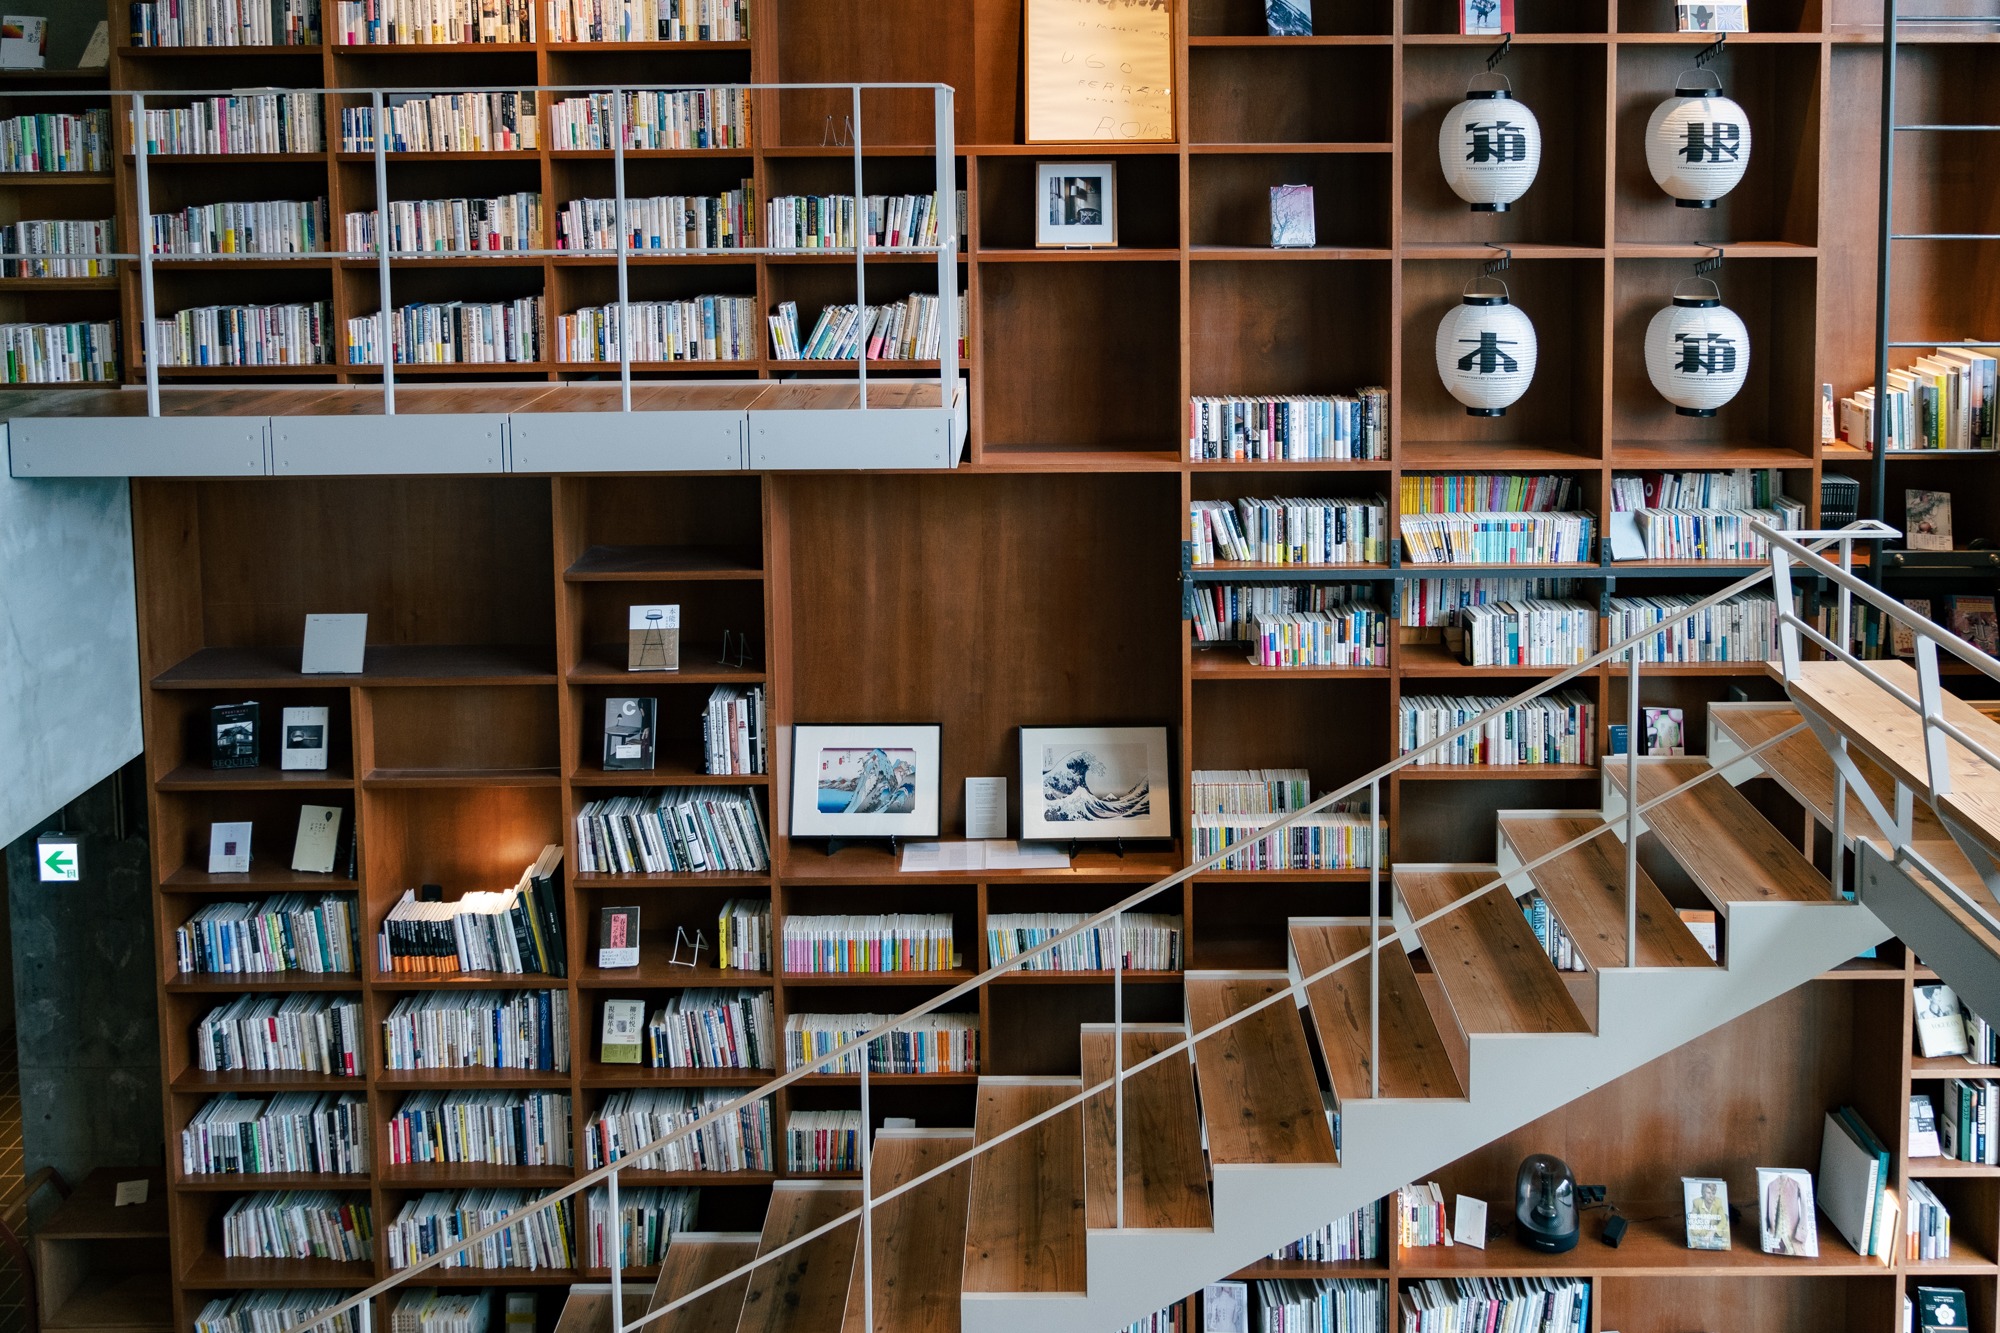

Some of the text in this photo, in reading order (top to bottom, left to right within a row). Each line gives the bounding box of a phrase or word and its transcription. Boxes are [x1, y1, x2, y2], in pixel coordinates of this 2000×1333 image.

[1061, 51, 1133, 74] UGO
[1465, 120, 1526, 164] 箱
[1456, 330, 1519, 375] 本
[1674, 333, 1736, 374] 箱
[622, 700, 636, 715] C
[212, 756, 258, 768] REQUIEM
[1534, 899, 1545, 930] BEAMS
